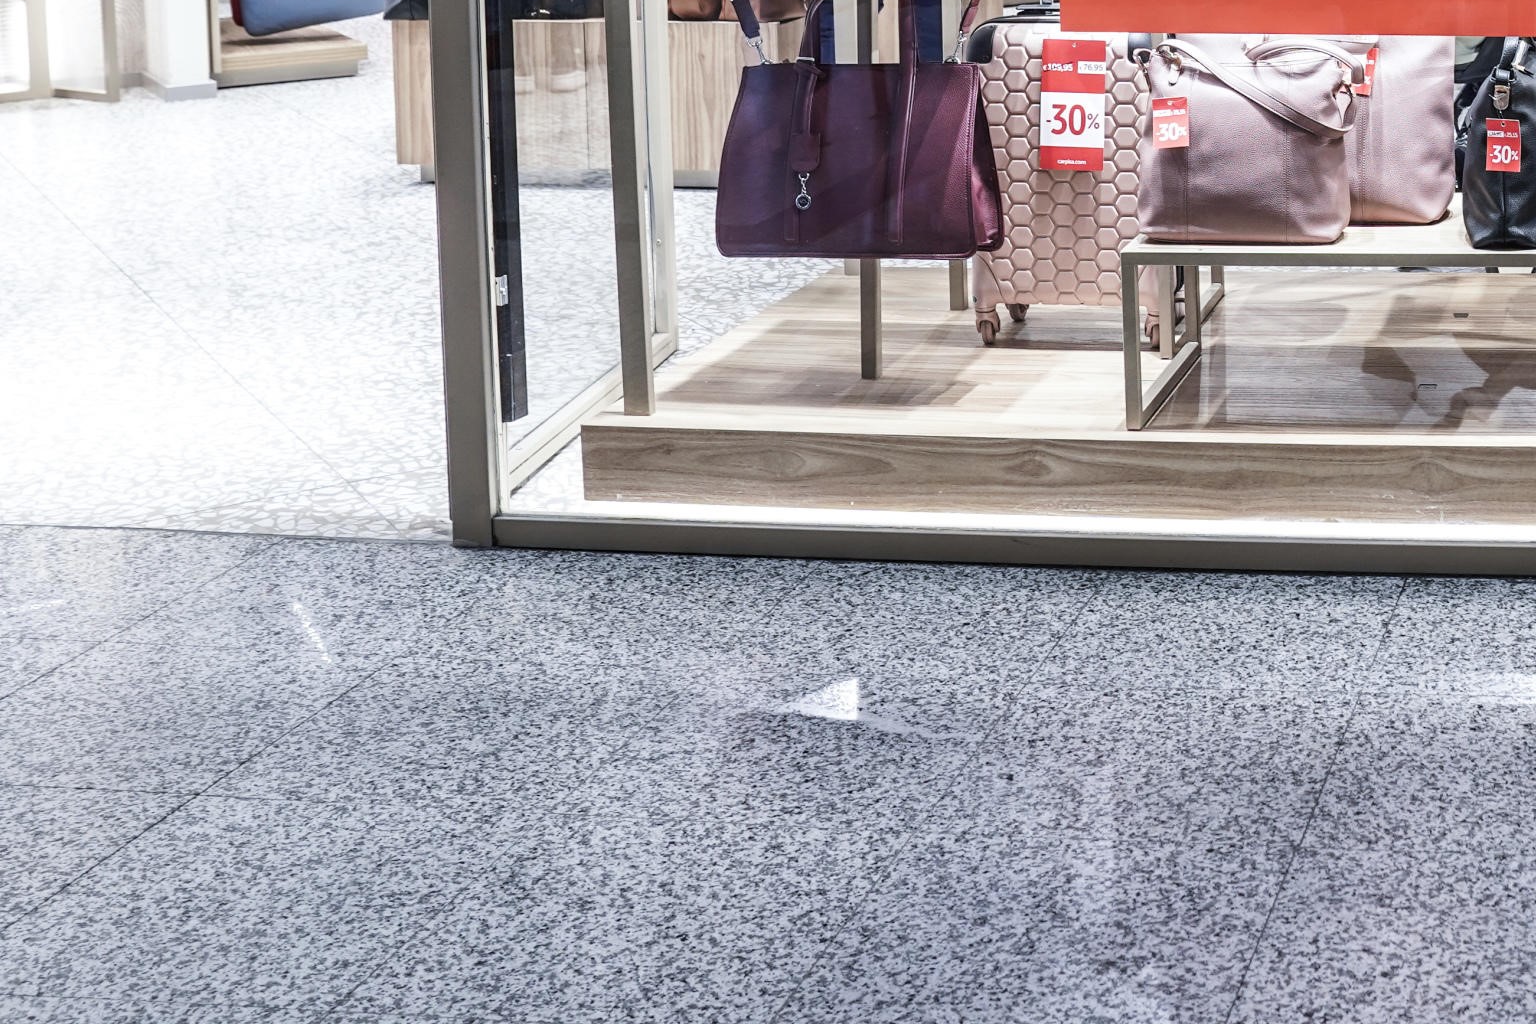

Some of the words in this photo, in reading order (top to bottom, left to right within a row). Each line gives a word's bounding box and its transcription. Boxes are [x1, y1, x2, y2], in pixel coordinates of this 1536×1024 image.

[1045, 103, 1100, 136] -30%
[1155, 122, 1188, 142] -30%
[1489, 144, 1519, 164] -30%
